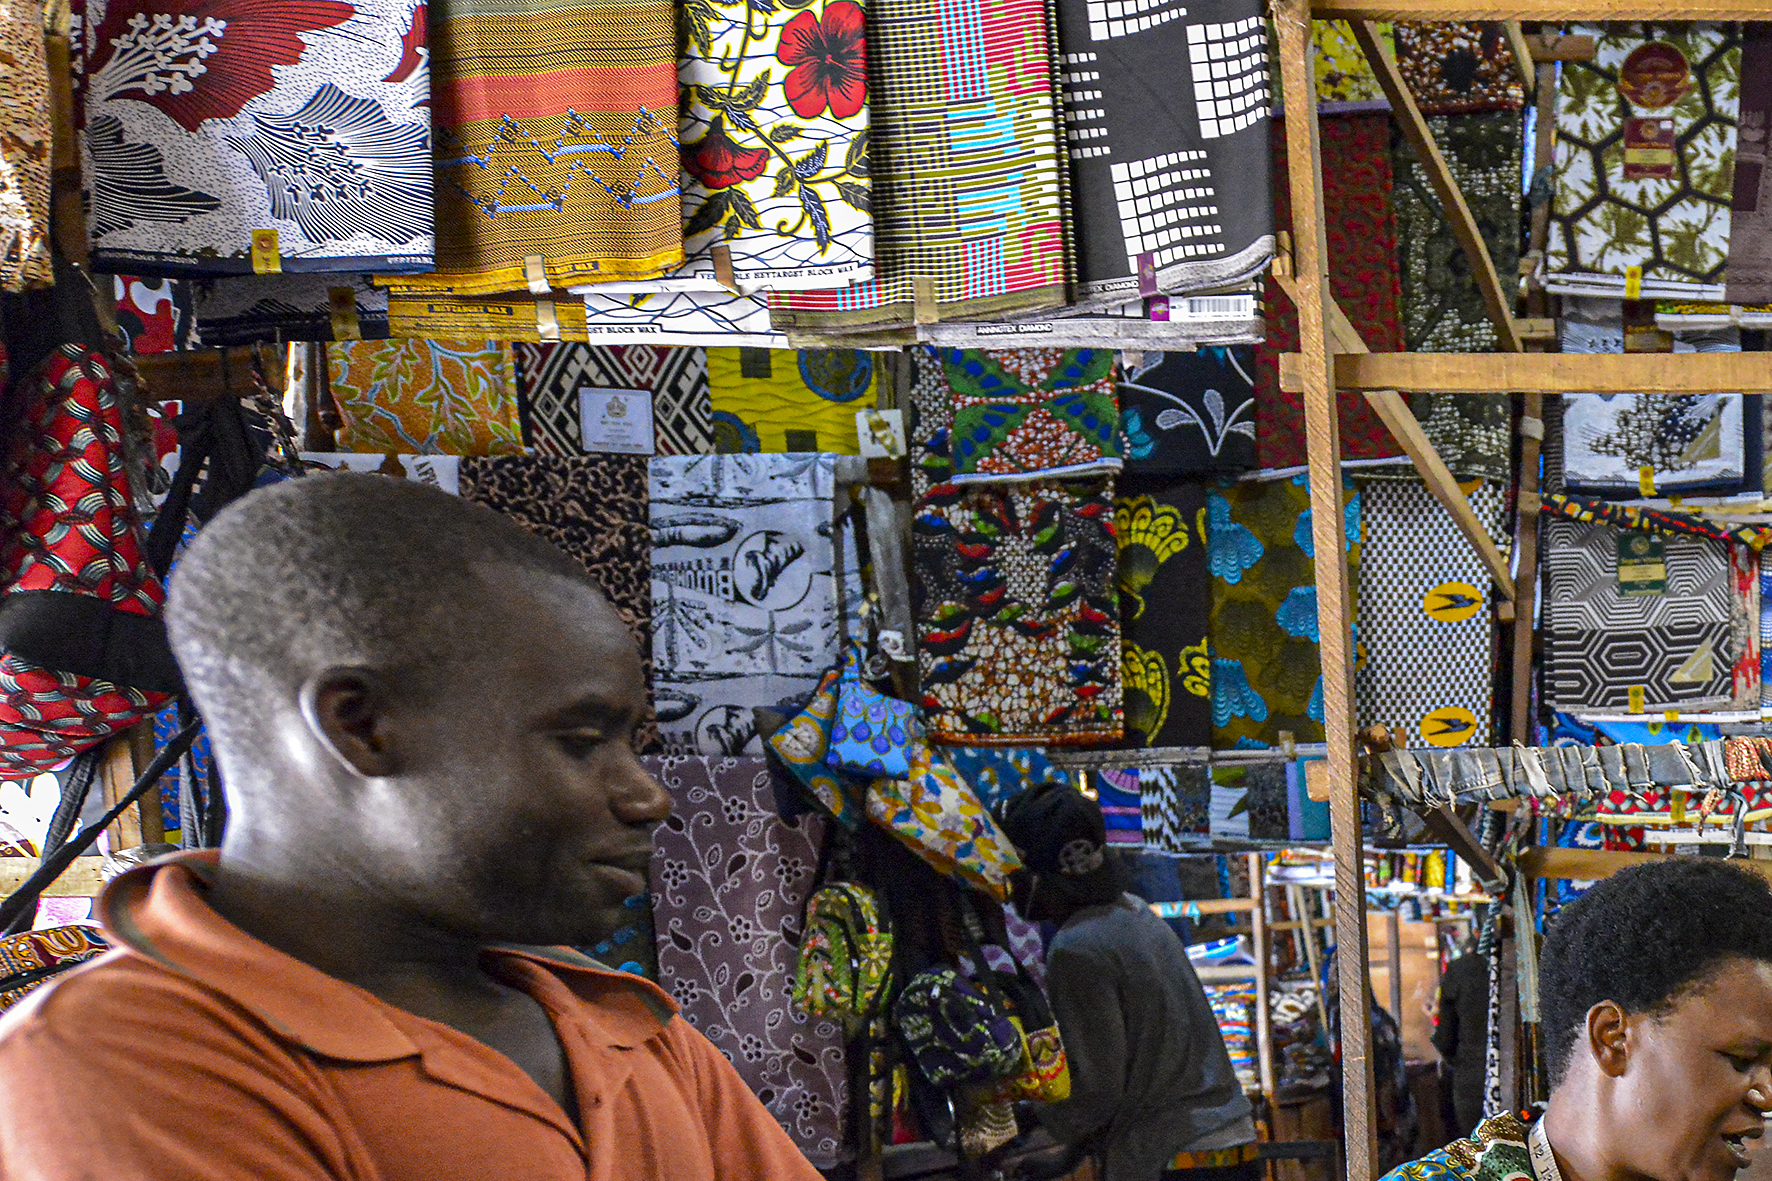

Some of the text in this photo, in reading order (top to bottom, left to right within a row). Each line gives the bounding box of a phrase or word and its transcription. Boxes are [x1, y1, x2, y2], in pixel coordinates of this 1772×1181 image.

[806, 267, 834, 278] BLOCK
[837, 264, 854, 274] WAX
[609, 325, 634, 335] BLOCK
[637, 326, 657, 335] WAX
[1018, 323, 1053, 333] DIAMOND
[1533, 1142, 1545, 1159] 12
